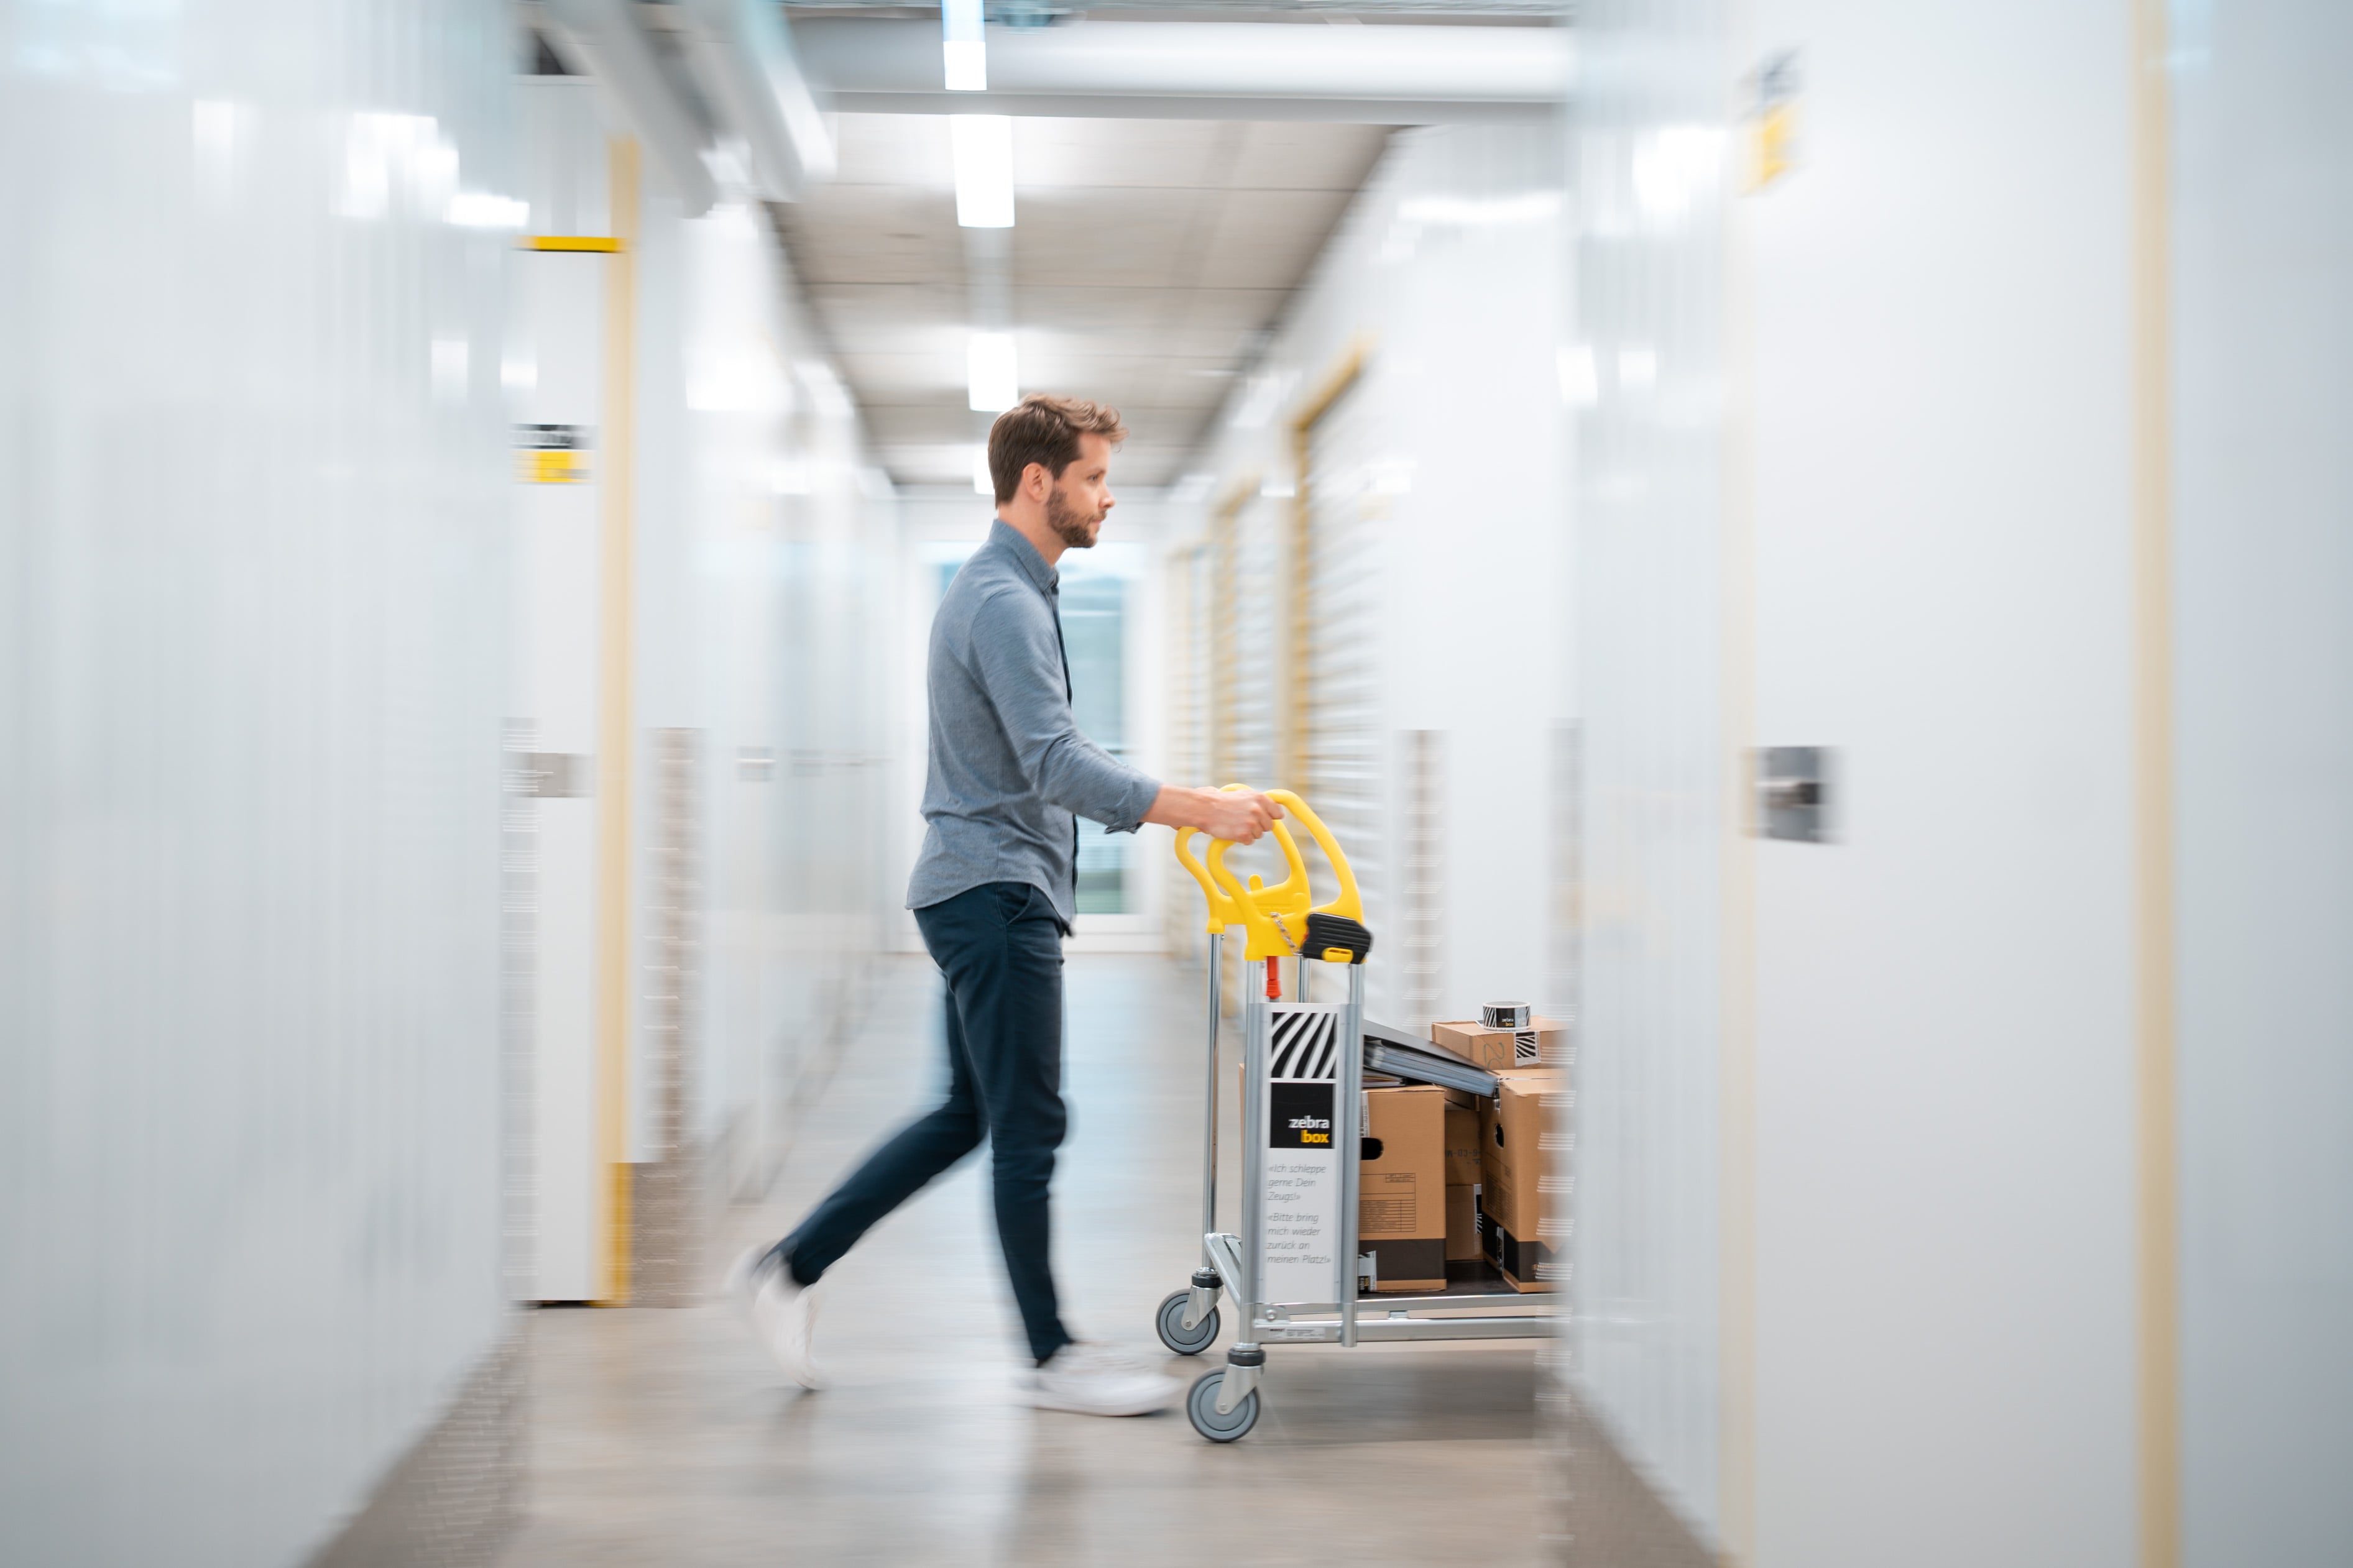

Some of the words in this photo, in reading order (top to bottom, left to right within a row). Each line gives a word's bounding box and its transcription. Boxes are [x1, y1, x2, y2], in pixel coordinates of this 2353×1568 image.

[1288, 1115, 1330, 1129] zebra
[1301, 1129, 1330, 1143] box
[1269, 1163, 1287, 1173] «Ich
[1289, 1164, 1327, 1175] schleppe
[1267, 1179, 1293, 1189] gerne
[1295, 1178, 1317, 1187] Dein
[1268, 1213, 1294, 1222] «Bitte
[1296, 1213, 1319, 1224] bring
[1268, 1227, 1289, 1236] mich
[1292, 1227, 1321, 1236] wieder
[1266, 1240, 1296, 1250] zurück
[1268, 1255, 1299, 1263] meinen
